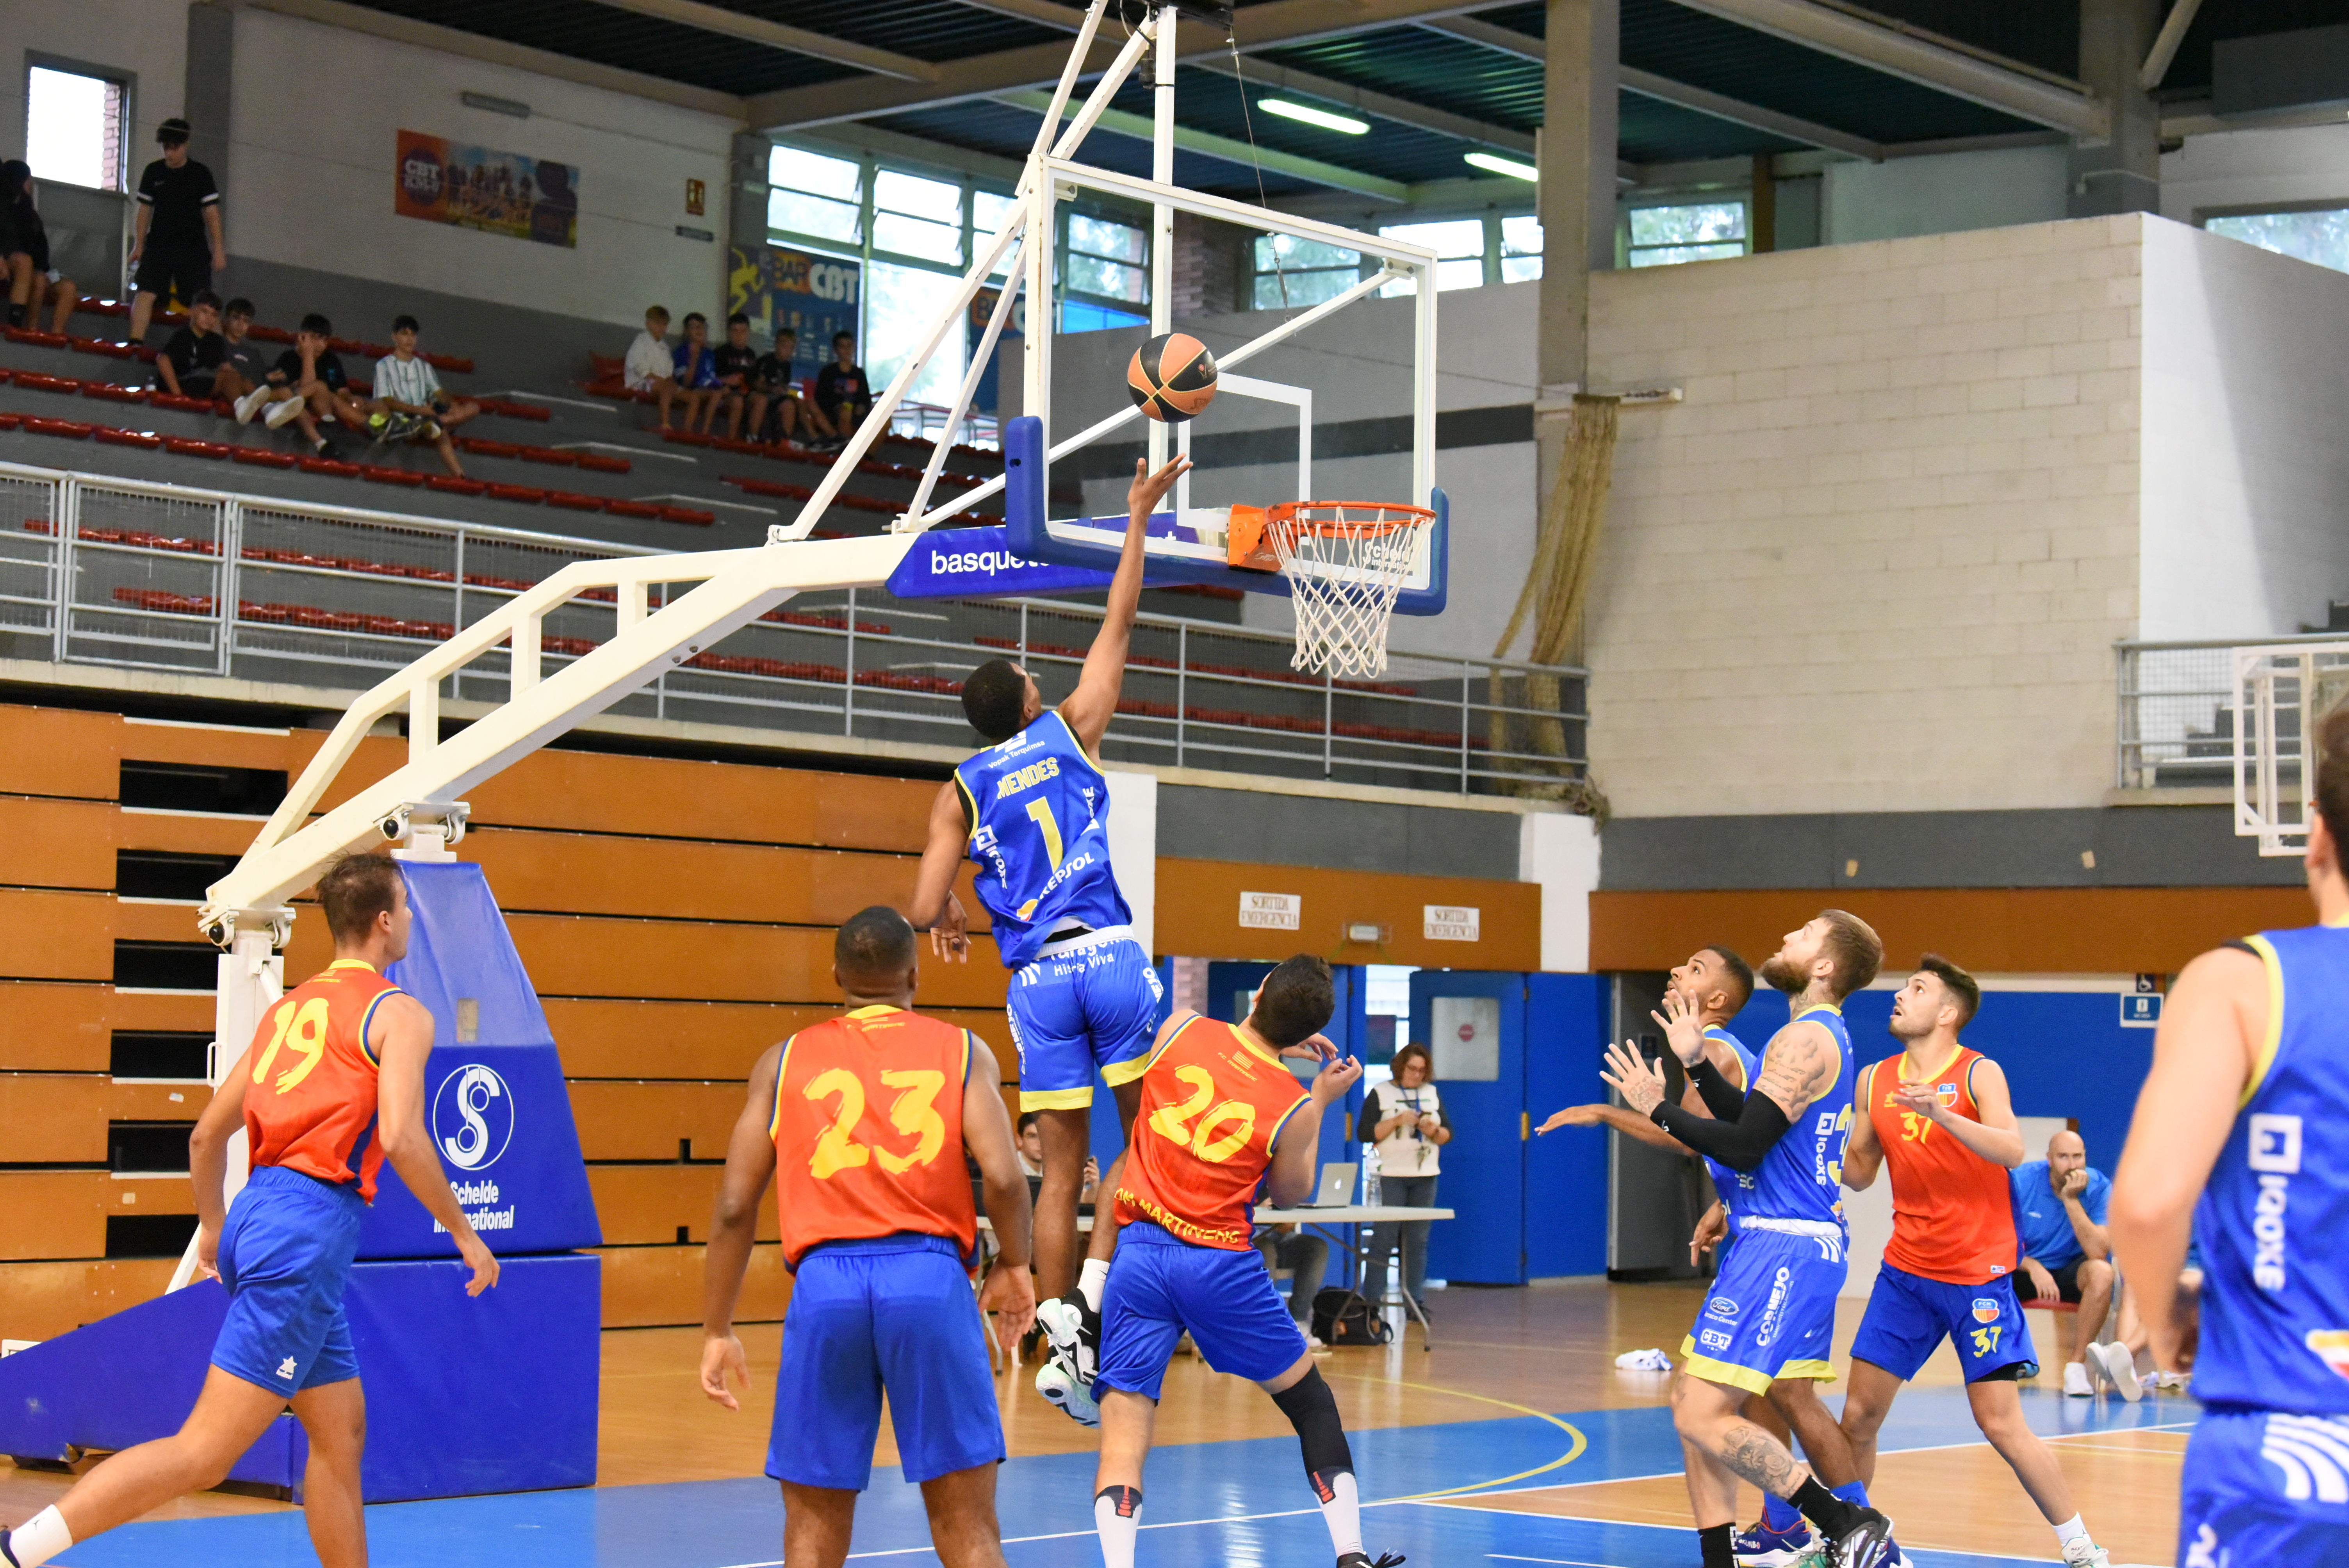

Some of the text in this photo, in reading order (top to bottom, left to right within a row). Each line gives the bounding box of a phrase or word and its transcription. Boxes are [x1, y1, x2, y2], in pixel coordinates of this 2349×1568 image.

[809, 263, 859, 305] CBT
[988, 741, 1045, 768] Vopak Terquimsa
[996, 757, 1060, 800] MENDES
[1025, 795, 1063, 875] 1
[1039, 852, 1095, 900] REPSOL
[1087, 953, 1114, 968] Viva
[252, 998, 329, 1095] 19
[802, 1068, 945, 1179] 23
[1148, 1063, 1255, 1163] 20
[1900, 1111, 1933, 1144] 37
[1816, 1137, 1827, 1186] IQOXE
[450, 1180, 499, 1205] Schelde
[1713, 1299, 1731, 1312] Ford
[1718, 1316, 1738, 1326] Center
[1756, 1267, 1790, 1346] CORNEJO
[1700, 1328, 1733, 1351] CBT
[1970, 1326, 2002, 1358] 37
